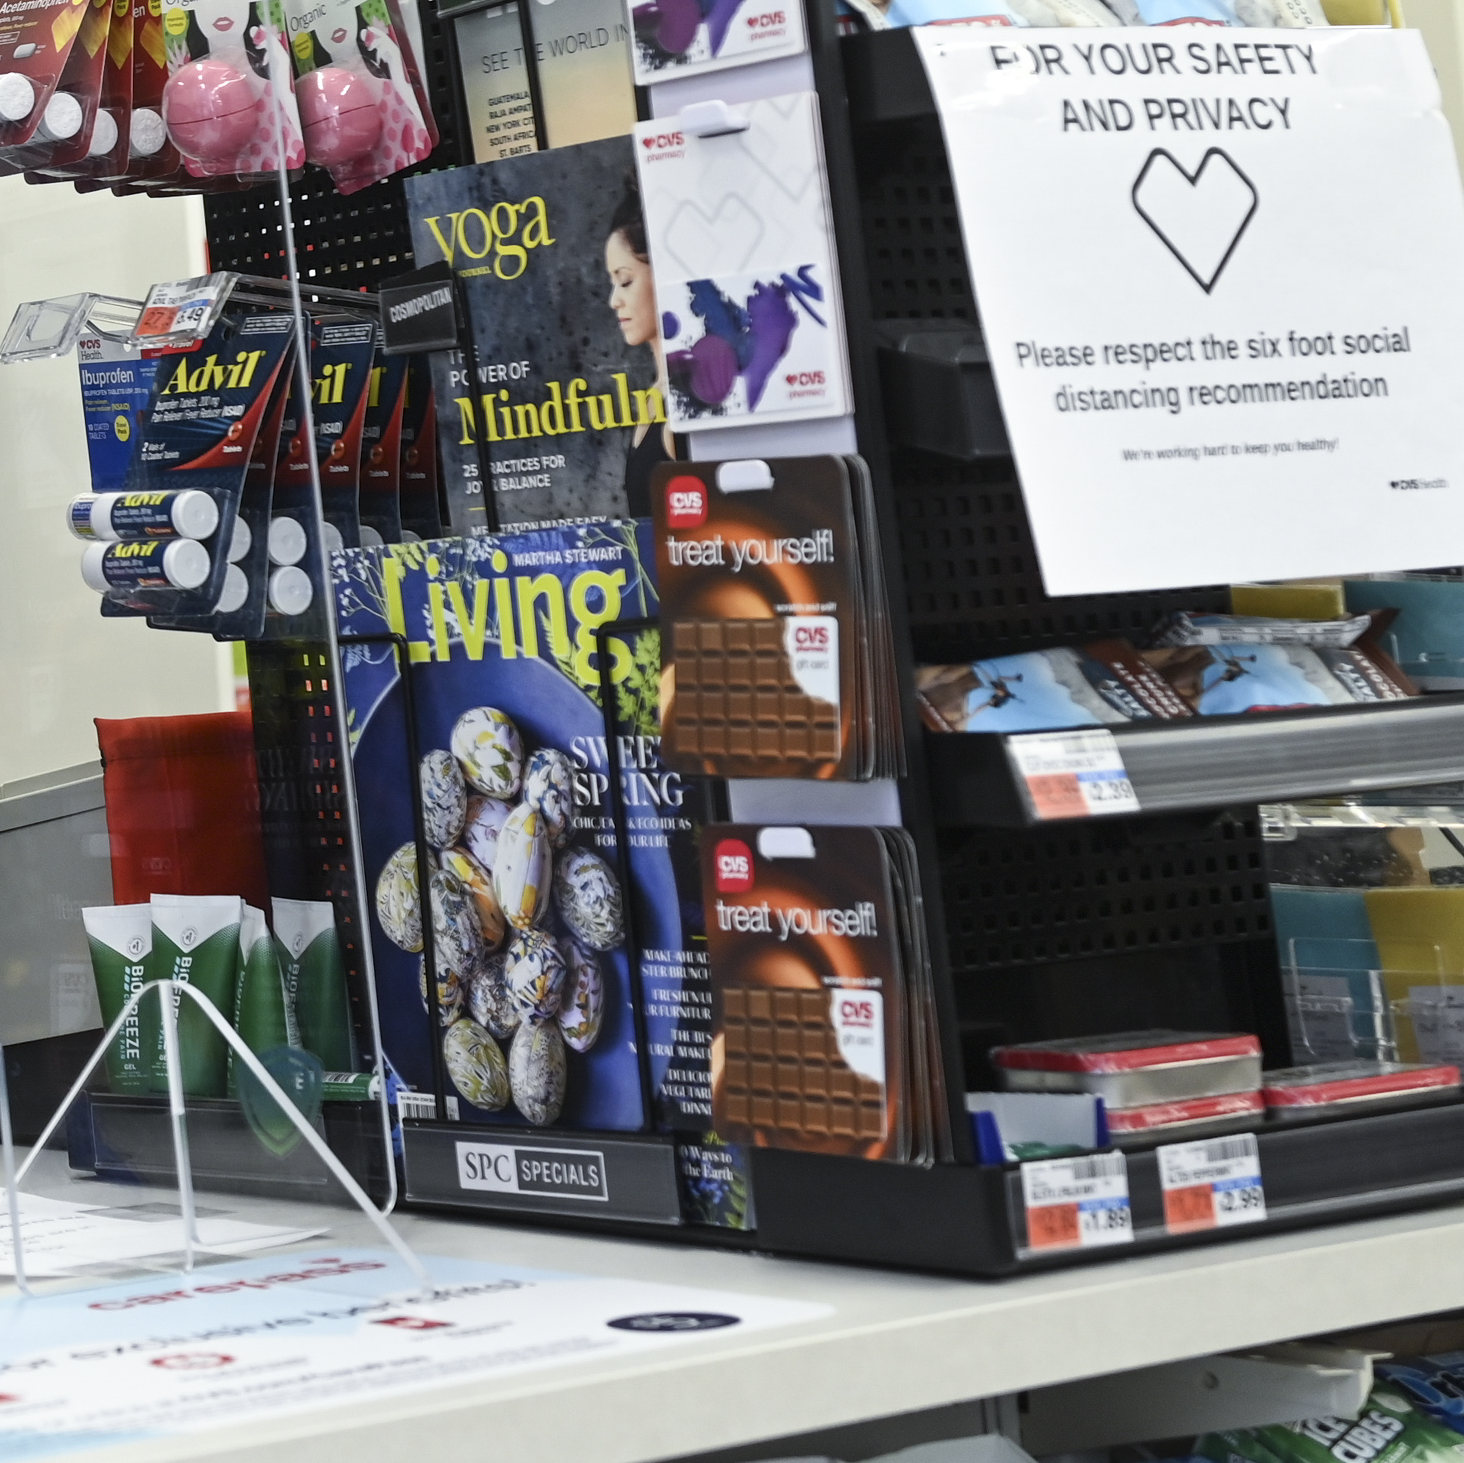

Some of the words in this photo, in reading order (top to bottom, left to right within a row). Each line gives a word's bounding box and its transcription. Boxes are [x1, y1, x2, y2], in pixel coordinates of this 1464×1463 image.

[291, 3, 326, 32] Organic
[758, 10, 786, 28] CVS
[749, 23, 786, 42] pharmacy
[483, 51, 510, 73] SEE
[547, 26, 610, 58] WORLD
[1073, 43, 1181, 75] YOUR
[1187, 43, 1319, 75] SAFETY
[488, 91, 530, 107] GUATEMALA
[489, 108, 506, 120] RAJA
[508, 103, 532, 117] AMPAT
[1061, 98, 1133, 132] AND
[1146, 96, 1292, 132] PRIVACY
[486, 122, 501, 133] NEW
[502, 119, 521, 131] YORK
[490, 135, 513, 147] SOUTH
[510, 144, 532, 156] BARTS
[656, 132, 685, 149] CVS
[646, 147, 686, 165] pharmacy
[424, 196, 556, 281] yoga
[389, 287, 452, 323] COSMOPOLITAN
[87, 339, 101, 349] CVS
[1015, 340, 1095, 369] Please
[1103, 336, 1196, 371] respect
[1202, 333, 1239, 360] the
[1248, 331, 1280, 359] six
[1289, 329, 1336, 358] foot
[1343, 327, 1411, 355] social
[81, 350, 103, 361] Health
[81, 367, 134, 387] Ibuprofen
[161, 350, 263, 395] Advil
[508, 361, 530, 379] OF
[798, 371, 826, 386] CVS
[788, 384, 826, 401] pharmacy
[1055, 381, 1180, 414] distancing
[1188, 372, 1389, 407] recommendation
[1157, 446, 1200, 461] working
[1244, 442, 1270, 458] keep
[1273, 442, 1295, 455] you
[462, 464, 479, 477] 25
[542, 454, 566, 469] FOR
[499, 474, 551, 491] BALANCE
[670, 492, 702, 509] CVS
[513, 550, 564, 568] MARTHA
[565, 546, 624, 564] STEWART
[667, 534, 725, 567] treat
[731, 528, 835, 573] yourself!
[382, 550, 633, 685] Living
[795, 626, 829, 645] CVS
[659, 817, 692, 830] IDEAS
[595, 835, 618, 847] FOR
[719, 855, 749, 872] CVS
[716, 899, 772, 933] treat
[776, 901, 878, 941] yourself!
[841, 1000, 873, 1019] CVS
[689, 1147, 718, 1165] Ways
[719, 1152, 732, 1165] to
[465, 1151, 512, 1183] SPC
[521, 1159, 600, 1188] SPECIALS
[684, 1164, 702, 1178] the
[703, 1164, 734, 1182] Earth
[1302, 1416, 1349, 1446] ICE
[1331, 1411, 1405, 1463] CUBES
